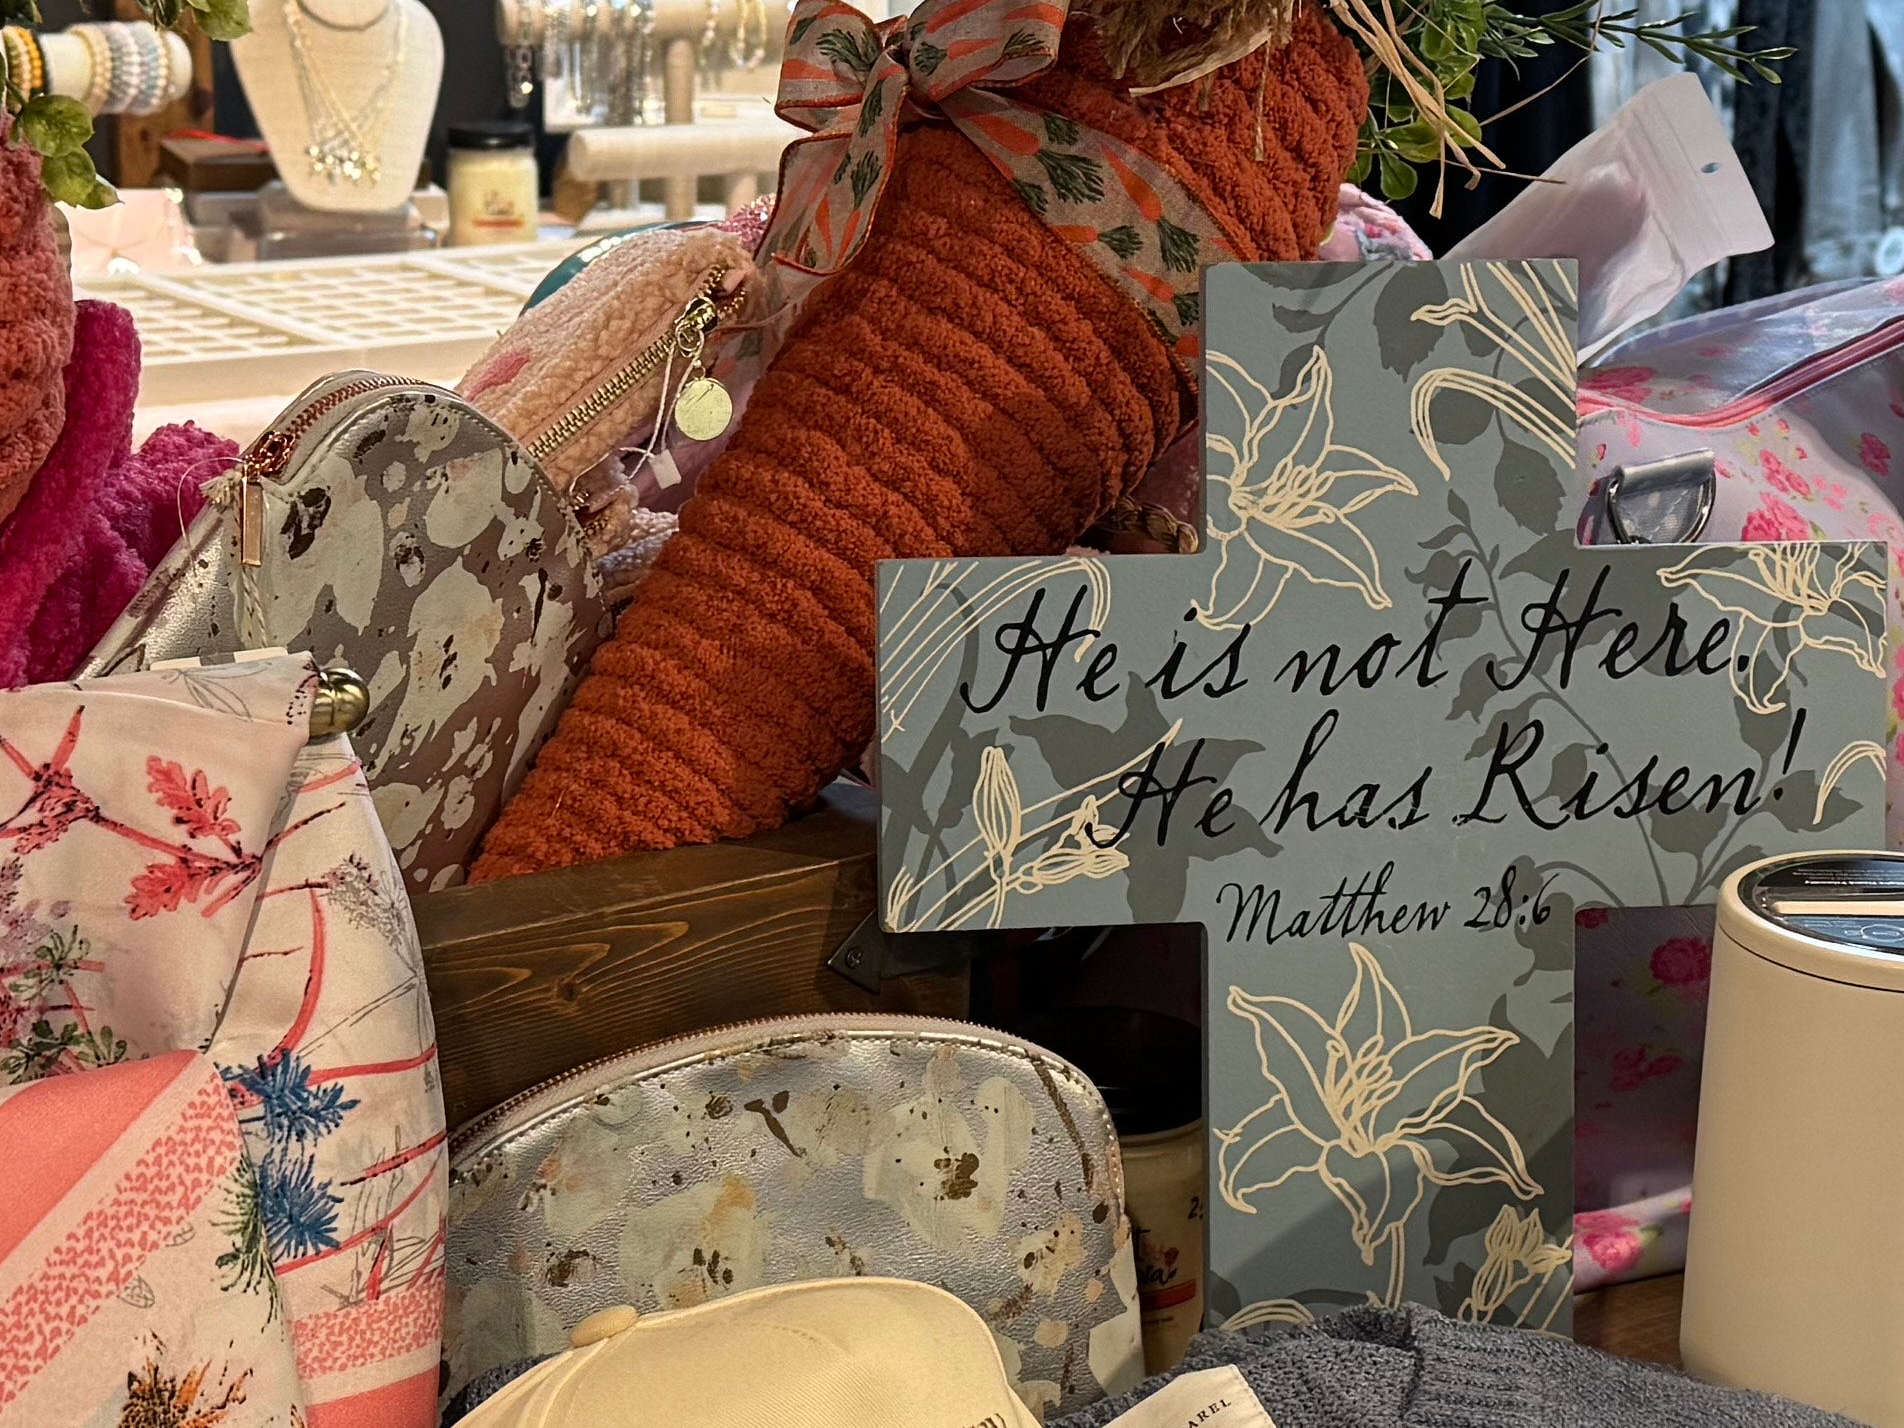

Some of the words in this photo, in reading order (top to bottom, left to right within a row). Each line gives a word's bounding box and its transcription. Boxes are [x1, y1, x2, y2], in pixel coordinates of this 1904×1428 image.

[959, 584, 1122, 714] He
[1144, 606, 1250, 700] is
[1273, 557, 1490, 696] not
[1486, 564, 1750, 691] Here.
[1084, 737, 1236, 848] He
[1258, 708, 1434, 834] has
[1452, 707, 1808, 831] Risen!
[1215, 860, 1452, 945] Matthew
[1463, 864, 1561, 929] 28:6
